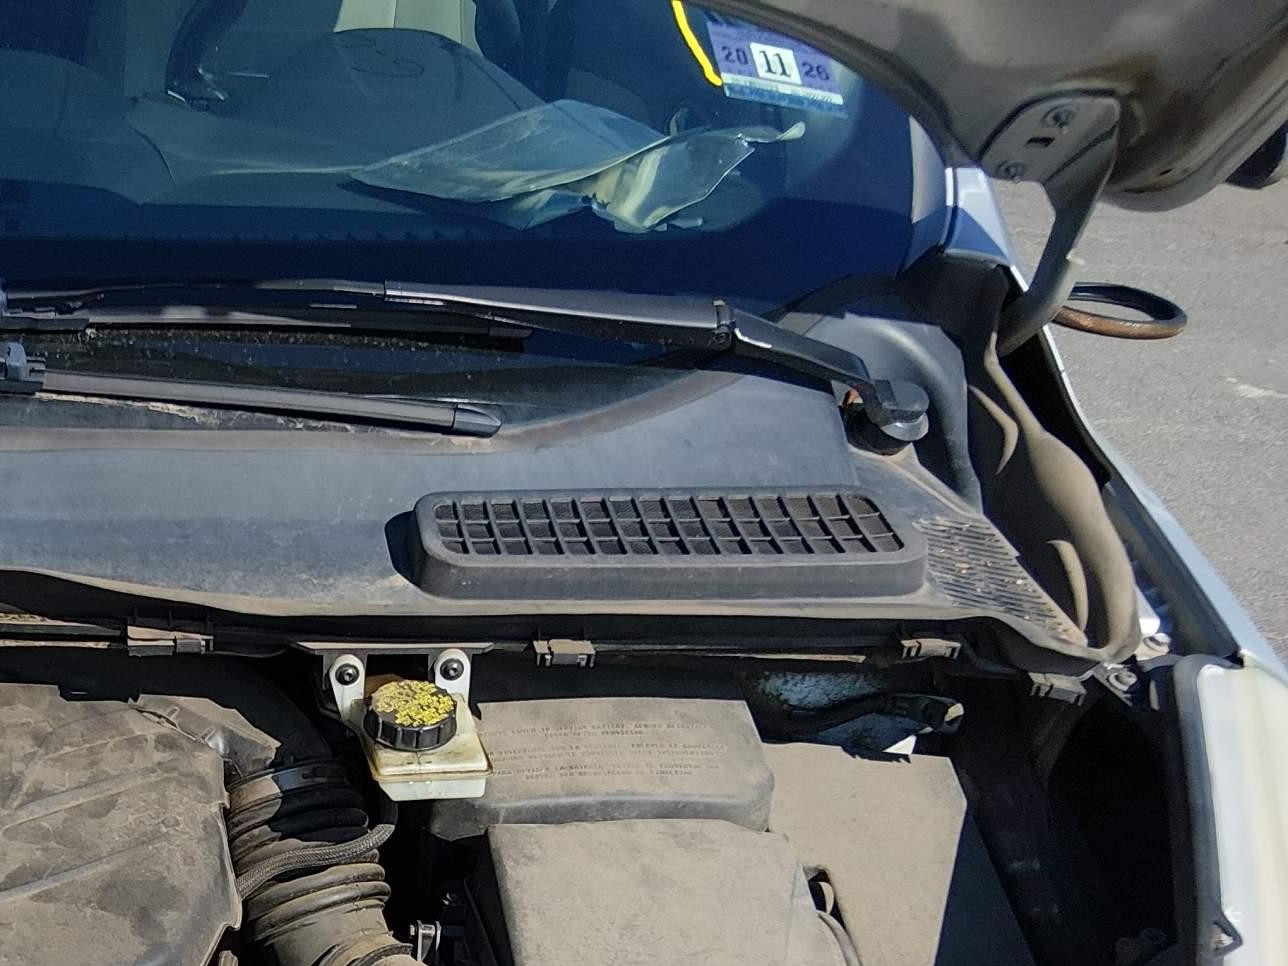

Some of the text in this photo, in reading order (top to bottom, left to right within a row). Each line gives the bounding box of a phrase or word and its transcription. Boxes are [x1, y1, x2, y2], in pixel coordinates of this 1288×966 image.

[721, 45, 831, 81] 20 11 26
